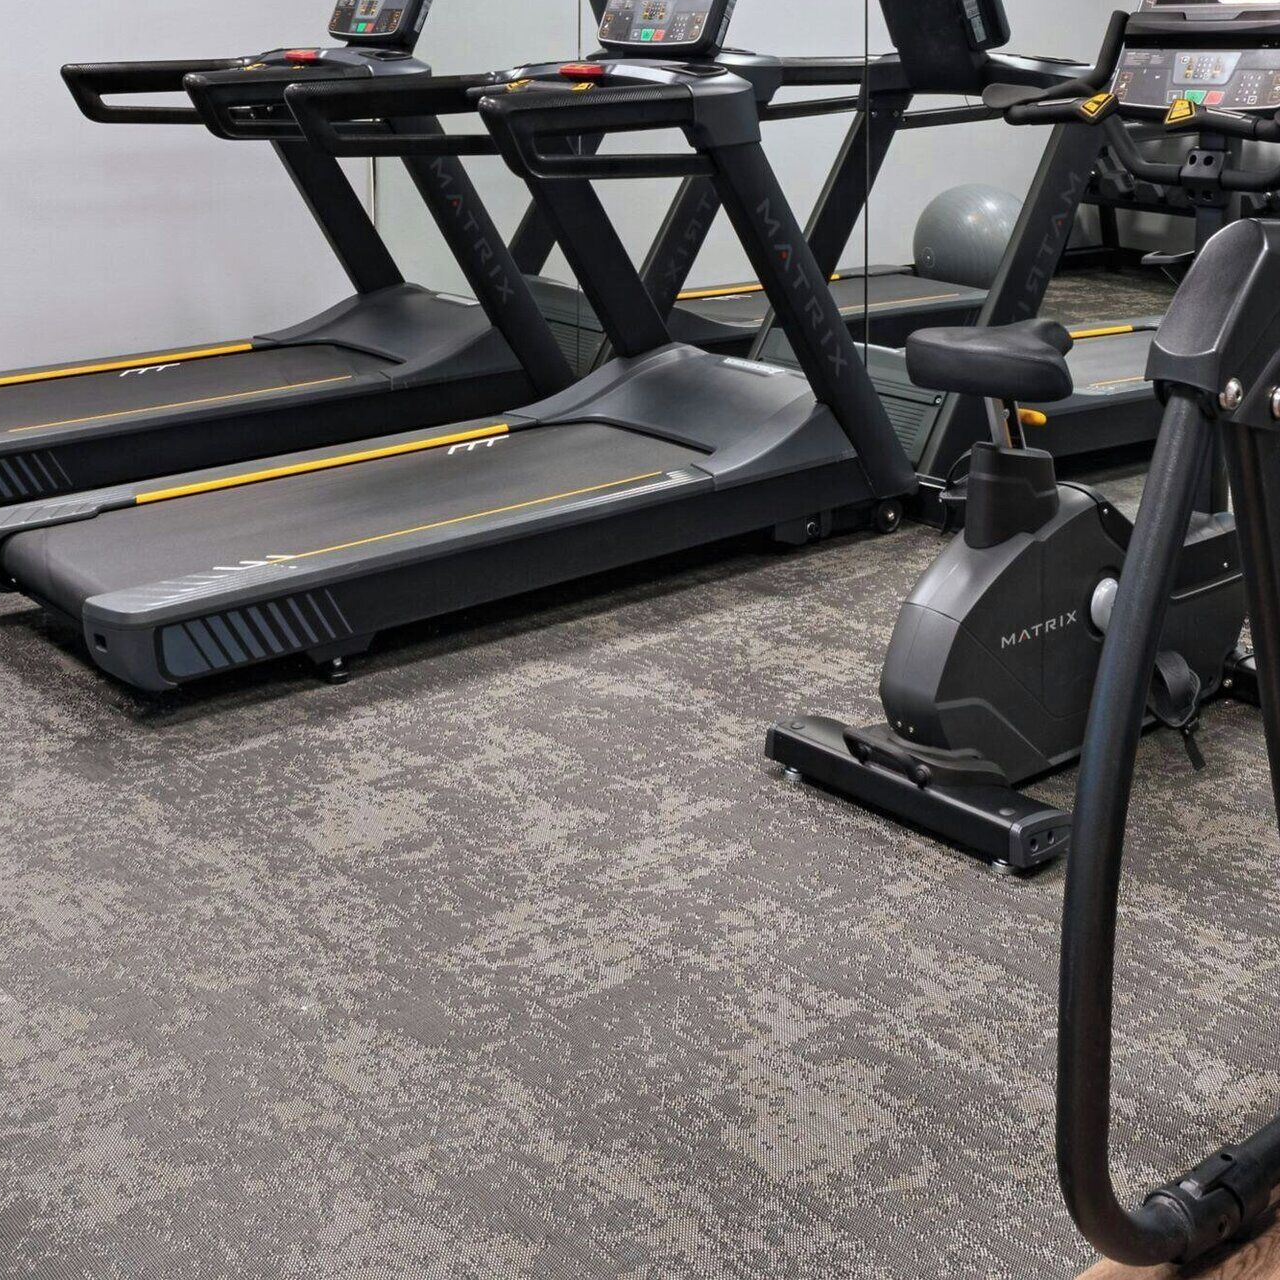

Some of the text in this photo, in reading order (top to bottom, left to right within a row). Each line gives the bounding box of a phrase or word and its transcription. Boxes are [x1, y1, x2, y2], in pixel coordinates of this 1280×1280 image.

[430, 156, 515, 304] MATRIX
[756, 198, 848, 377] MATRIX
[1001, 610, 1077, 649] MATRIX
